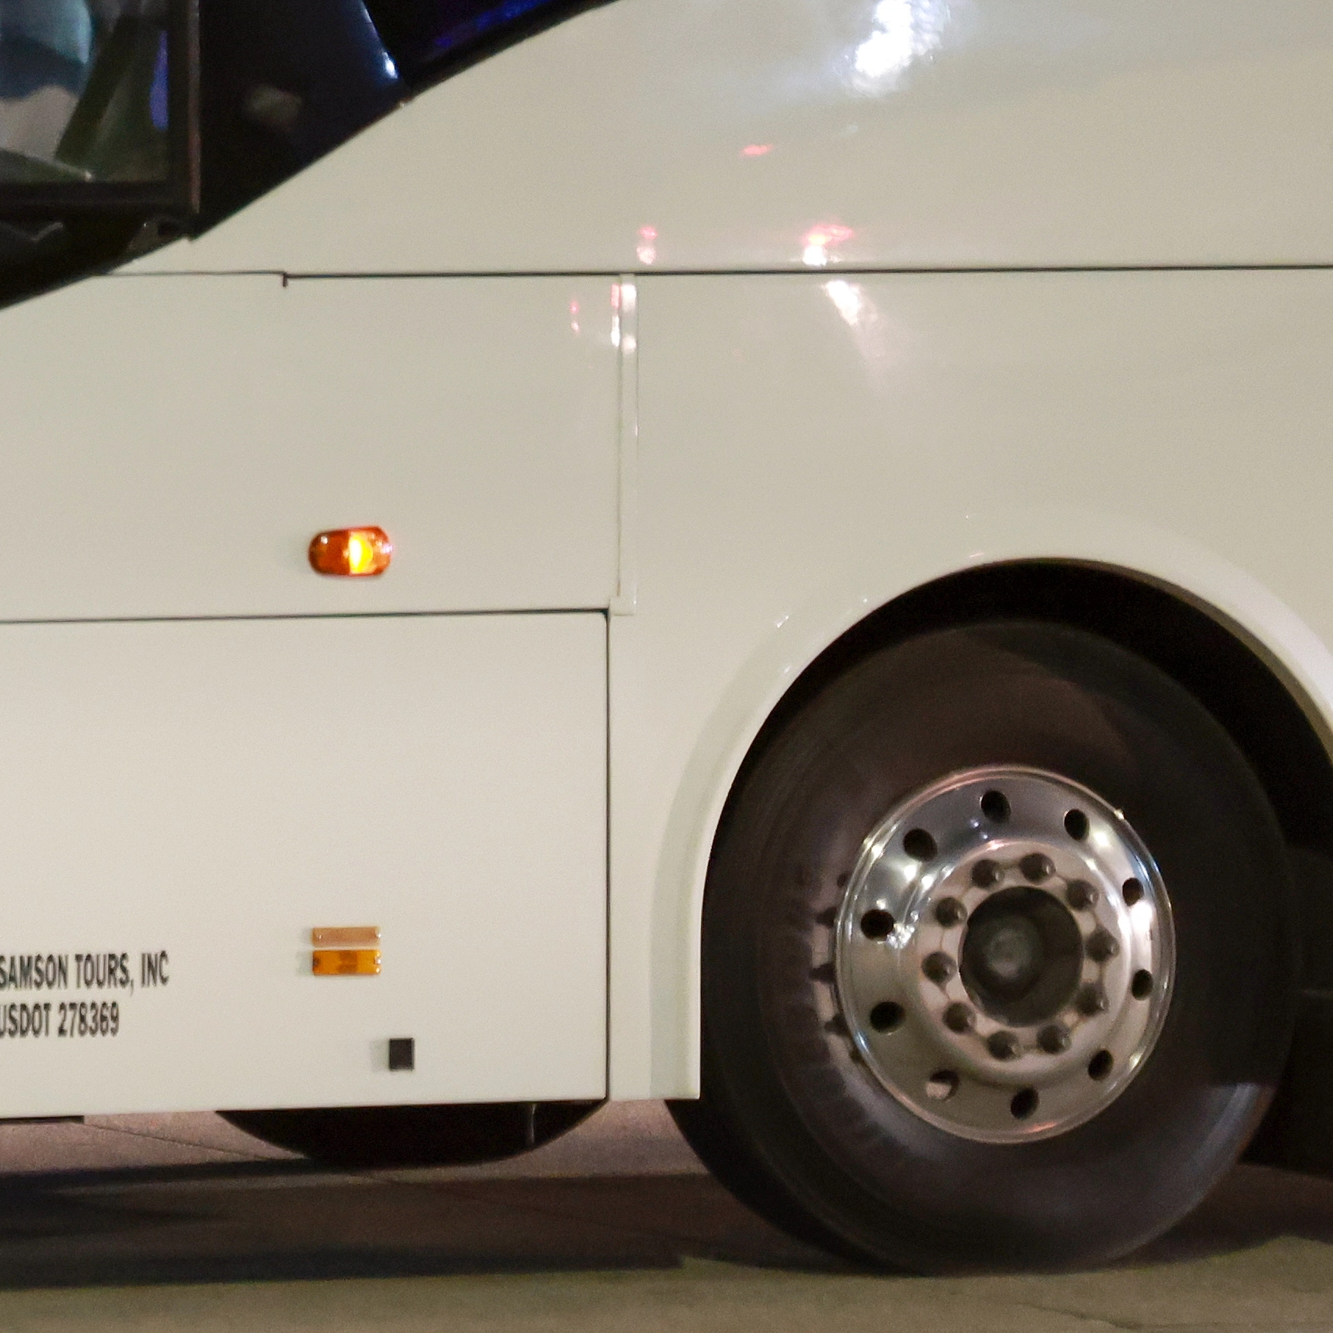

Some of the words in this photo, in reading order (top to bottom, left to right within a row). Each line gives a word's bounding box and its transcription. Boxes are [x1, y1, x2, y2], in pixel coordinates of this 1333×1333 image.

[74, 952, 135, 997] TOURS,
[140, 950, 169, 988] INC
[57, 1001, 120, 1038] 278369
